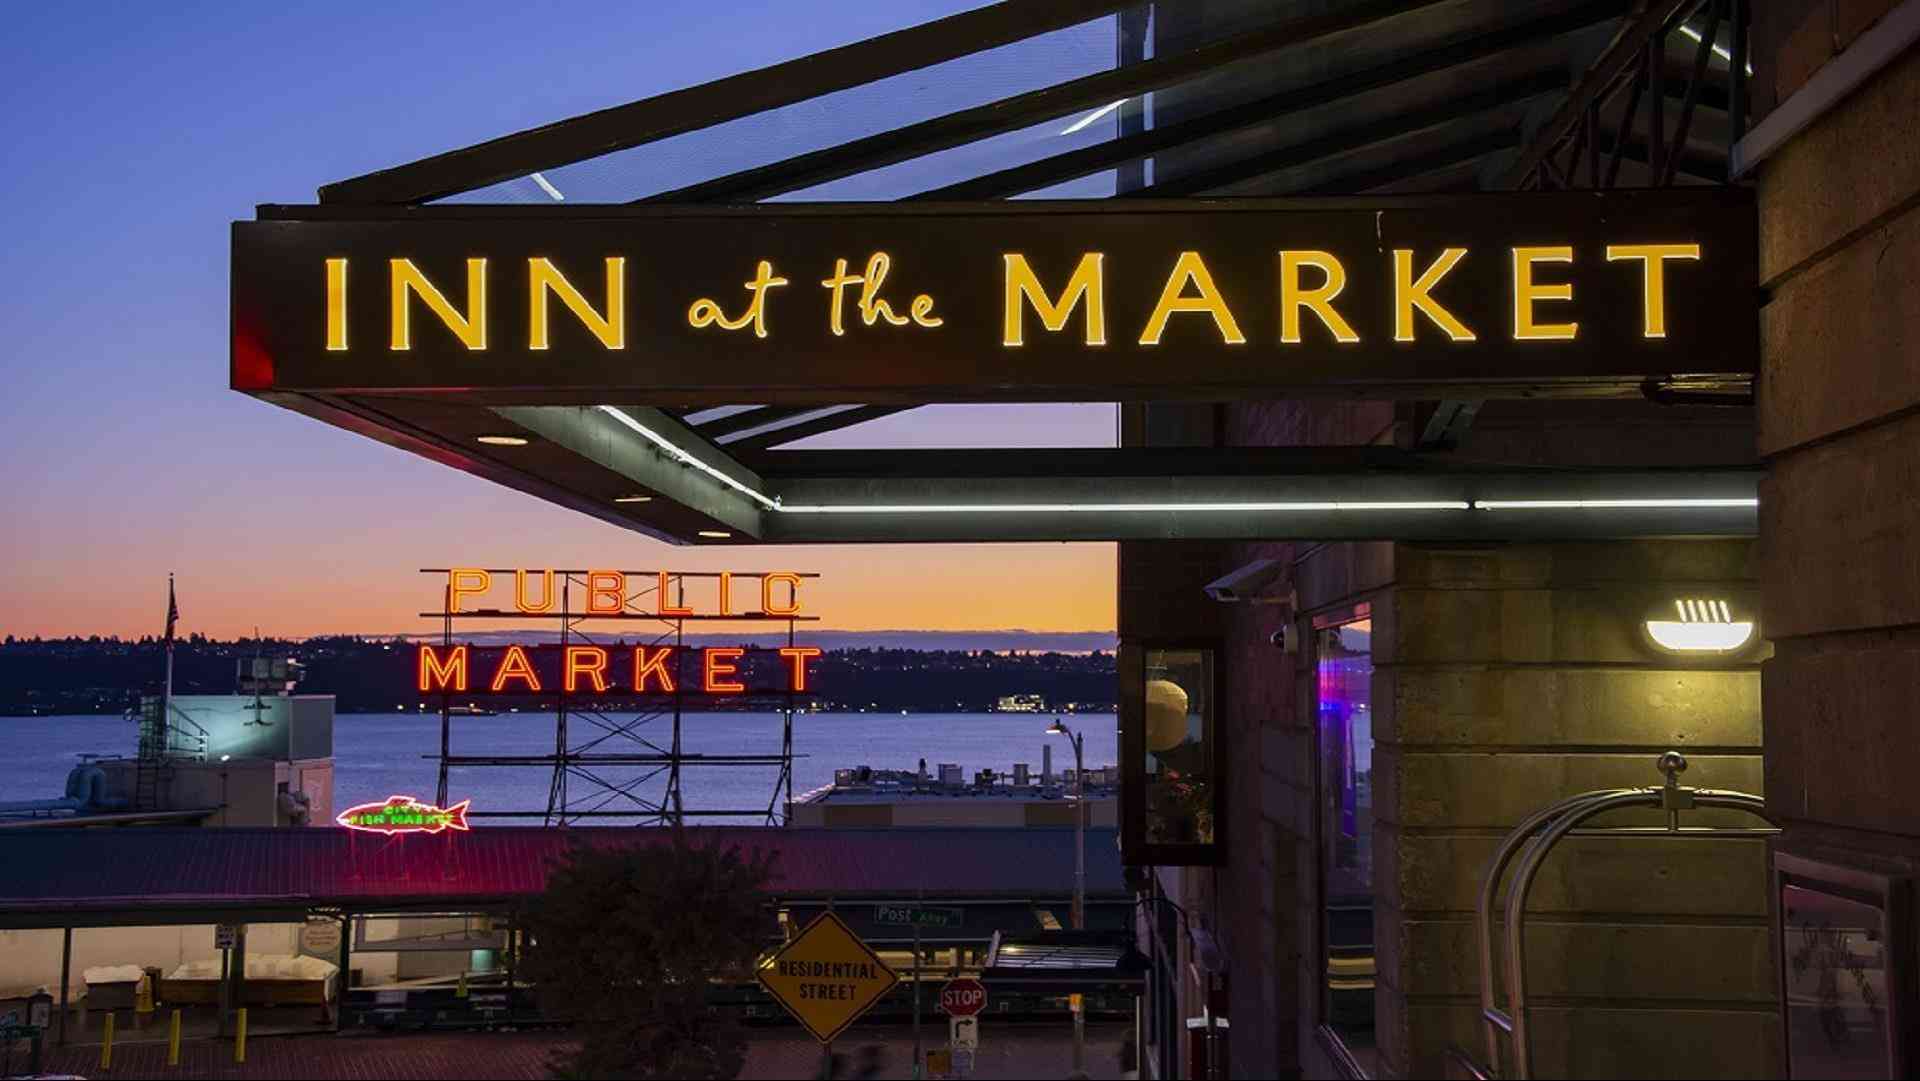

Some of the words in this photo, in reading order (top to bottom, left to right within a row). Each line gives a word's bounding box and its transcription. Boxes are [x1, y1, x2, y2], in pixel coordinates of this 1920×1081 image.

[325, 257, 627, 351] INN
[688, 260, 788, 338] at
[821, 251, 945, 336] the
[1002, 243, 1701, 347] MARKET
[448, 568, 806, 616] PUBLIC
[418, 646, 822, 692] MARKET
[878, 905, 912, 921] Post
[778, 960, 880, 980] RESIDENTIAL
[799, 983, 857, 1001] STREET
[943, 989, 983, 1006] STOP
